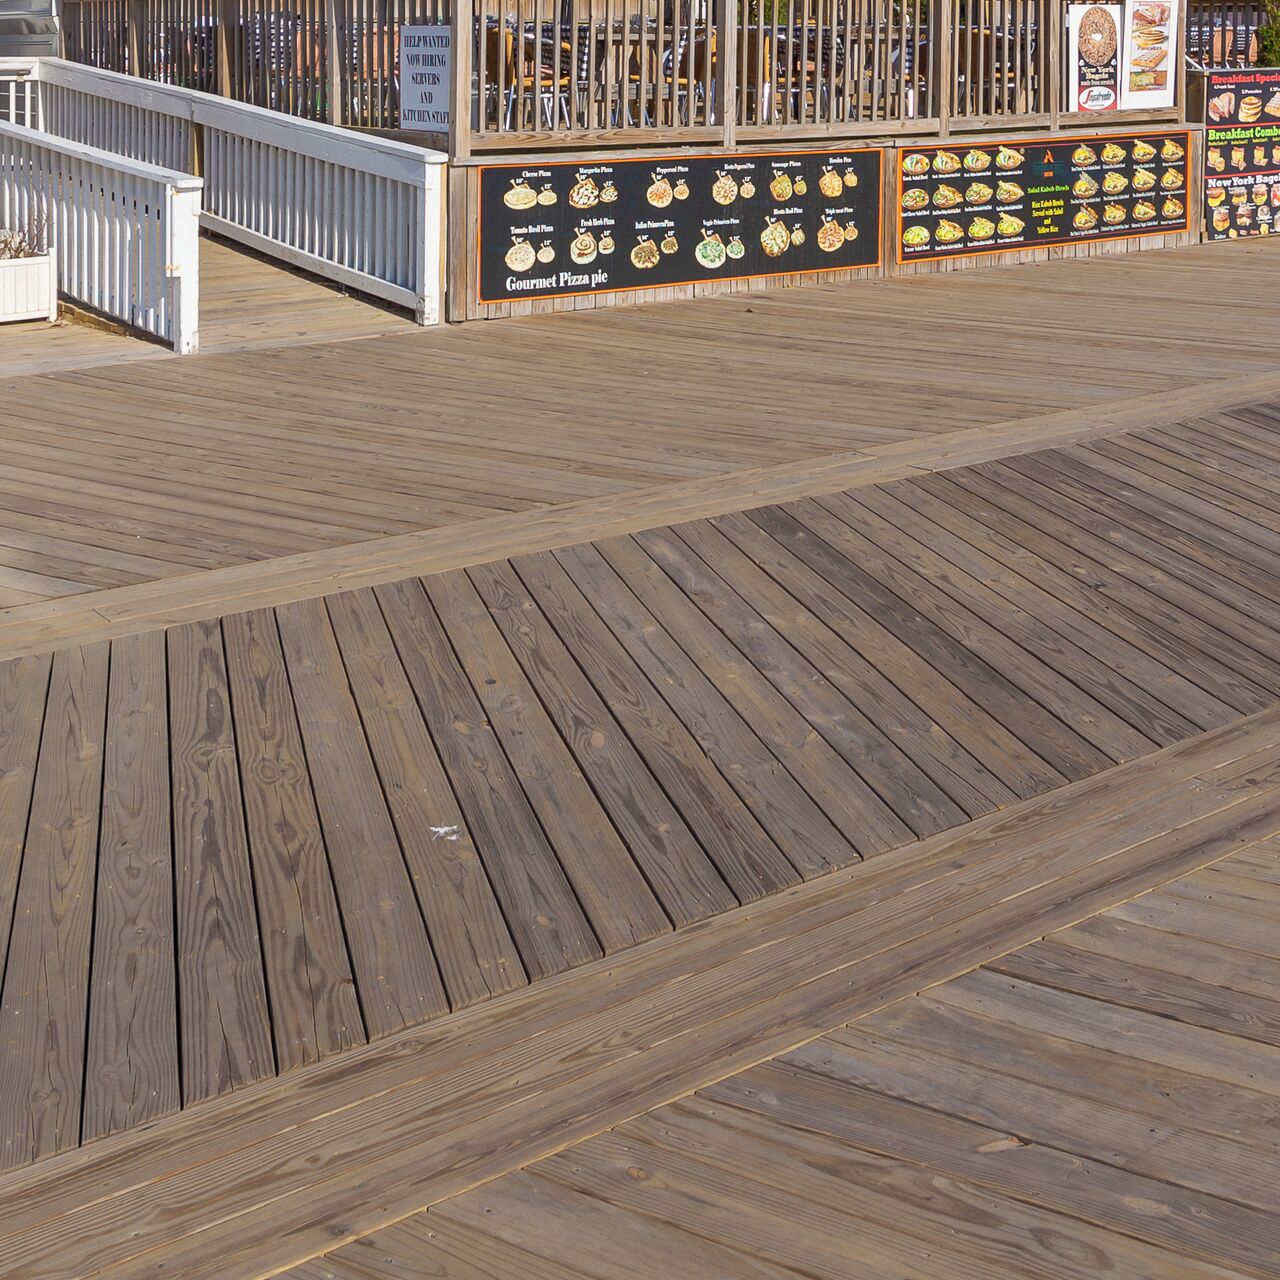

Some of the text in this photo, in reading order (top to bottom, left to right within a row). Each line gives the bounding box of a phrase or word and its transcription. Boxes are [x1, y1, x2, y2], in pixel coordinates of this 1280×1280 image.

[404, 35, 450, 48] HELP WANTED
[406, 53, 446, 67] NOW HIRING
[411, 73, 440, 85] SERVERS
[1211, 75, 1254, 84] Breakfast
[420, 91, 433, 104] AND
[402, 109, 430, 123] KITCHEN
[1208, 127, 1254, 140] Breakfast
[1208, 178, 1232, 187] New
[1232, 176, 1254, 186] York
[506, 269, 608, 291] Gourmet Pizza pie
